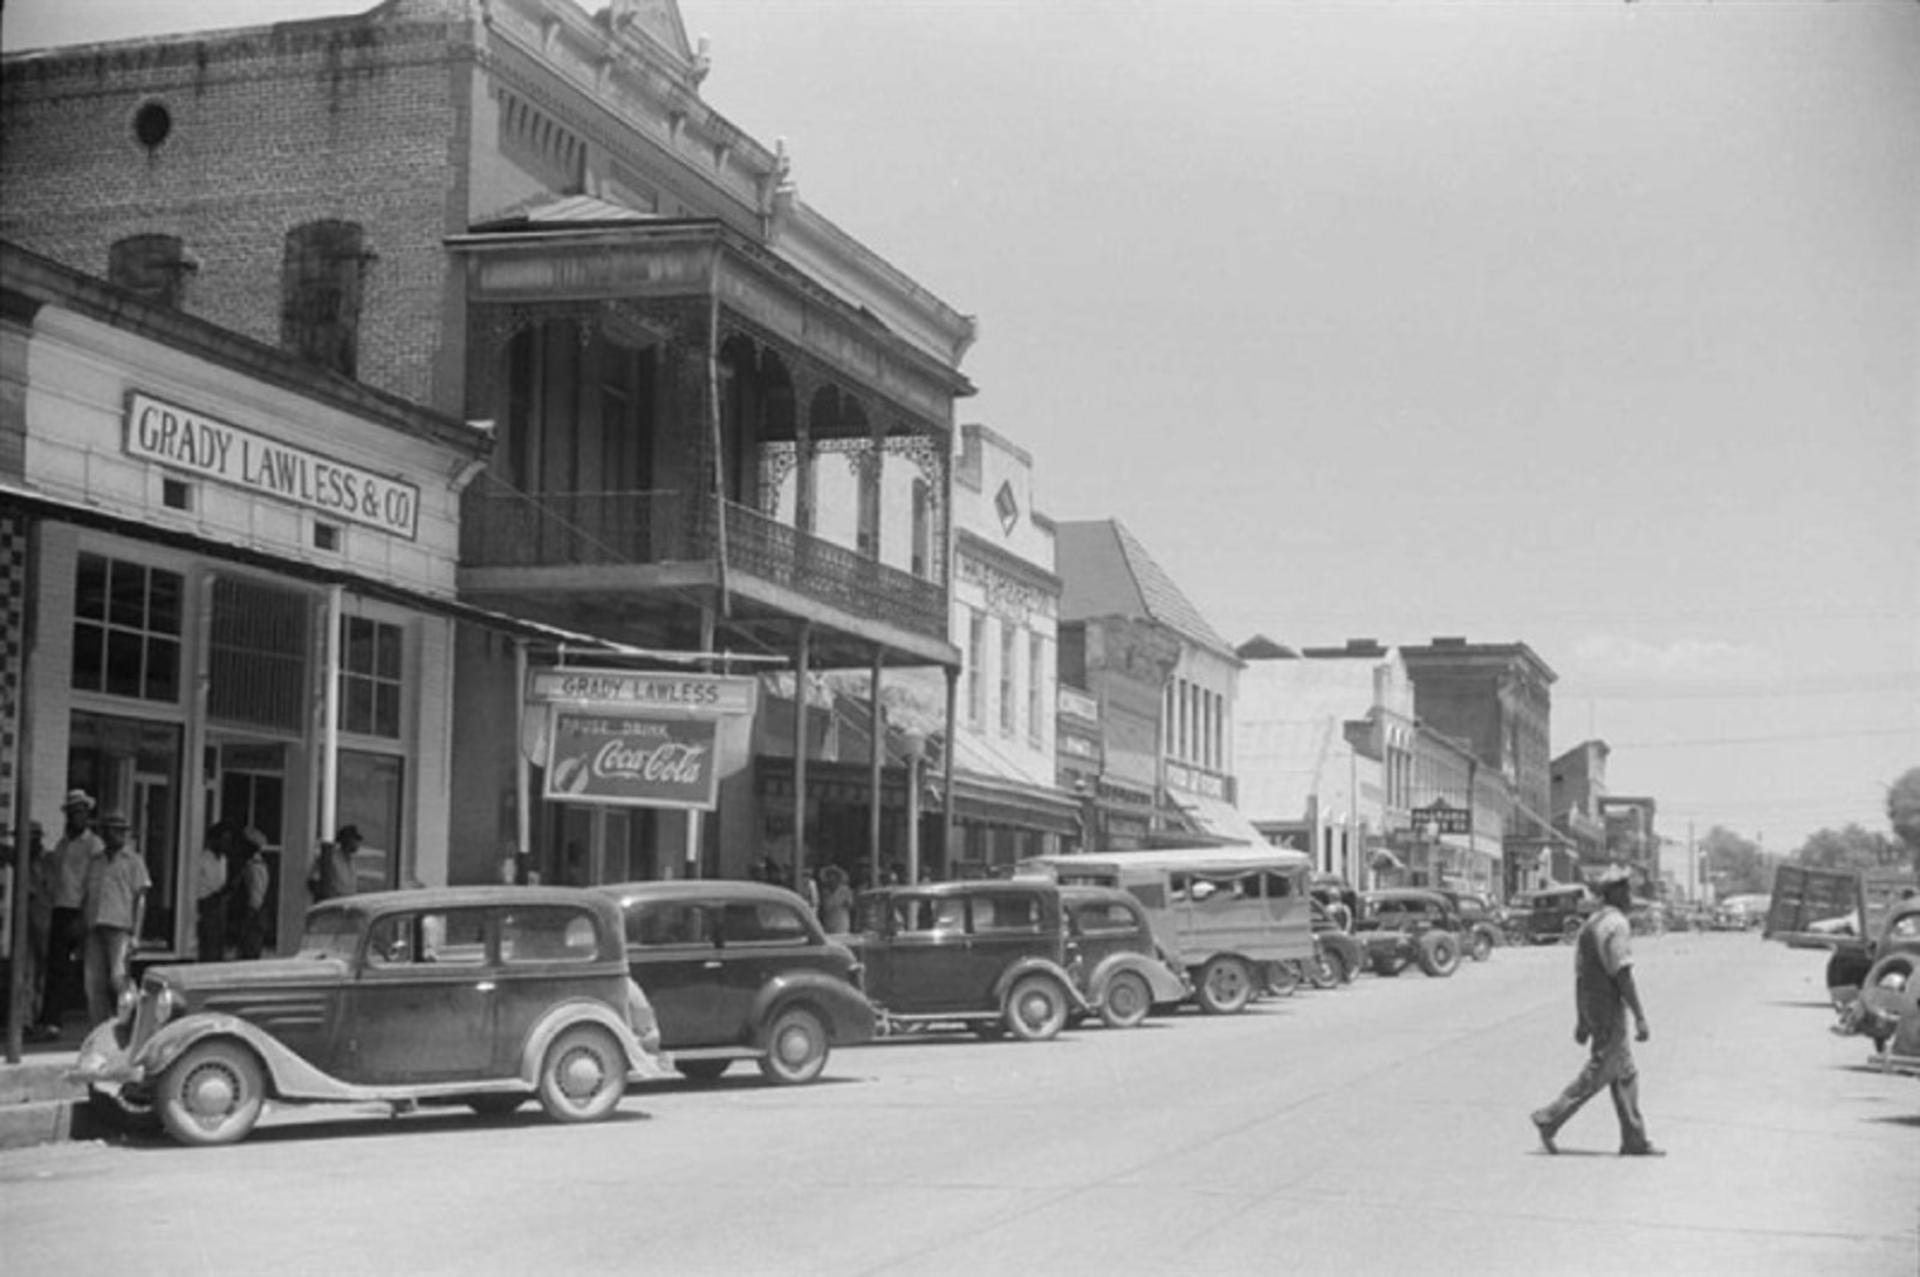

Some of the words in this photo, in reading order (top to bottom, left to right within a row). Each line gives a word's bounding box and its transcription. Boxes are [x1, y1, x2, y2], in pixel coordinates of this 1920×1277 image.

[139, 405, 232, 474] GRADY
[242, 440, 357, 514] LAWLESS
[362, 480, 379, 518] &
[562, 677, 622, 698] GRADY
[632, 680, 718, 701] LAWLESS
